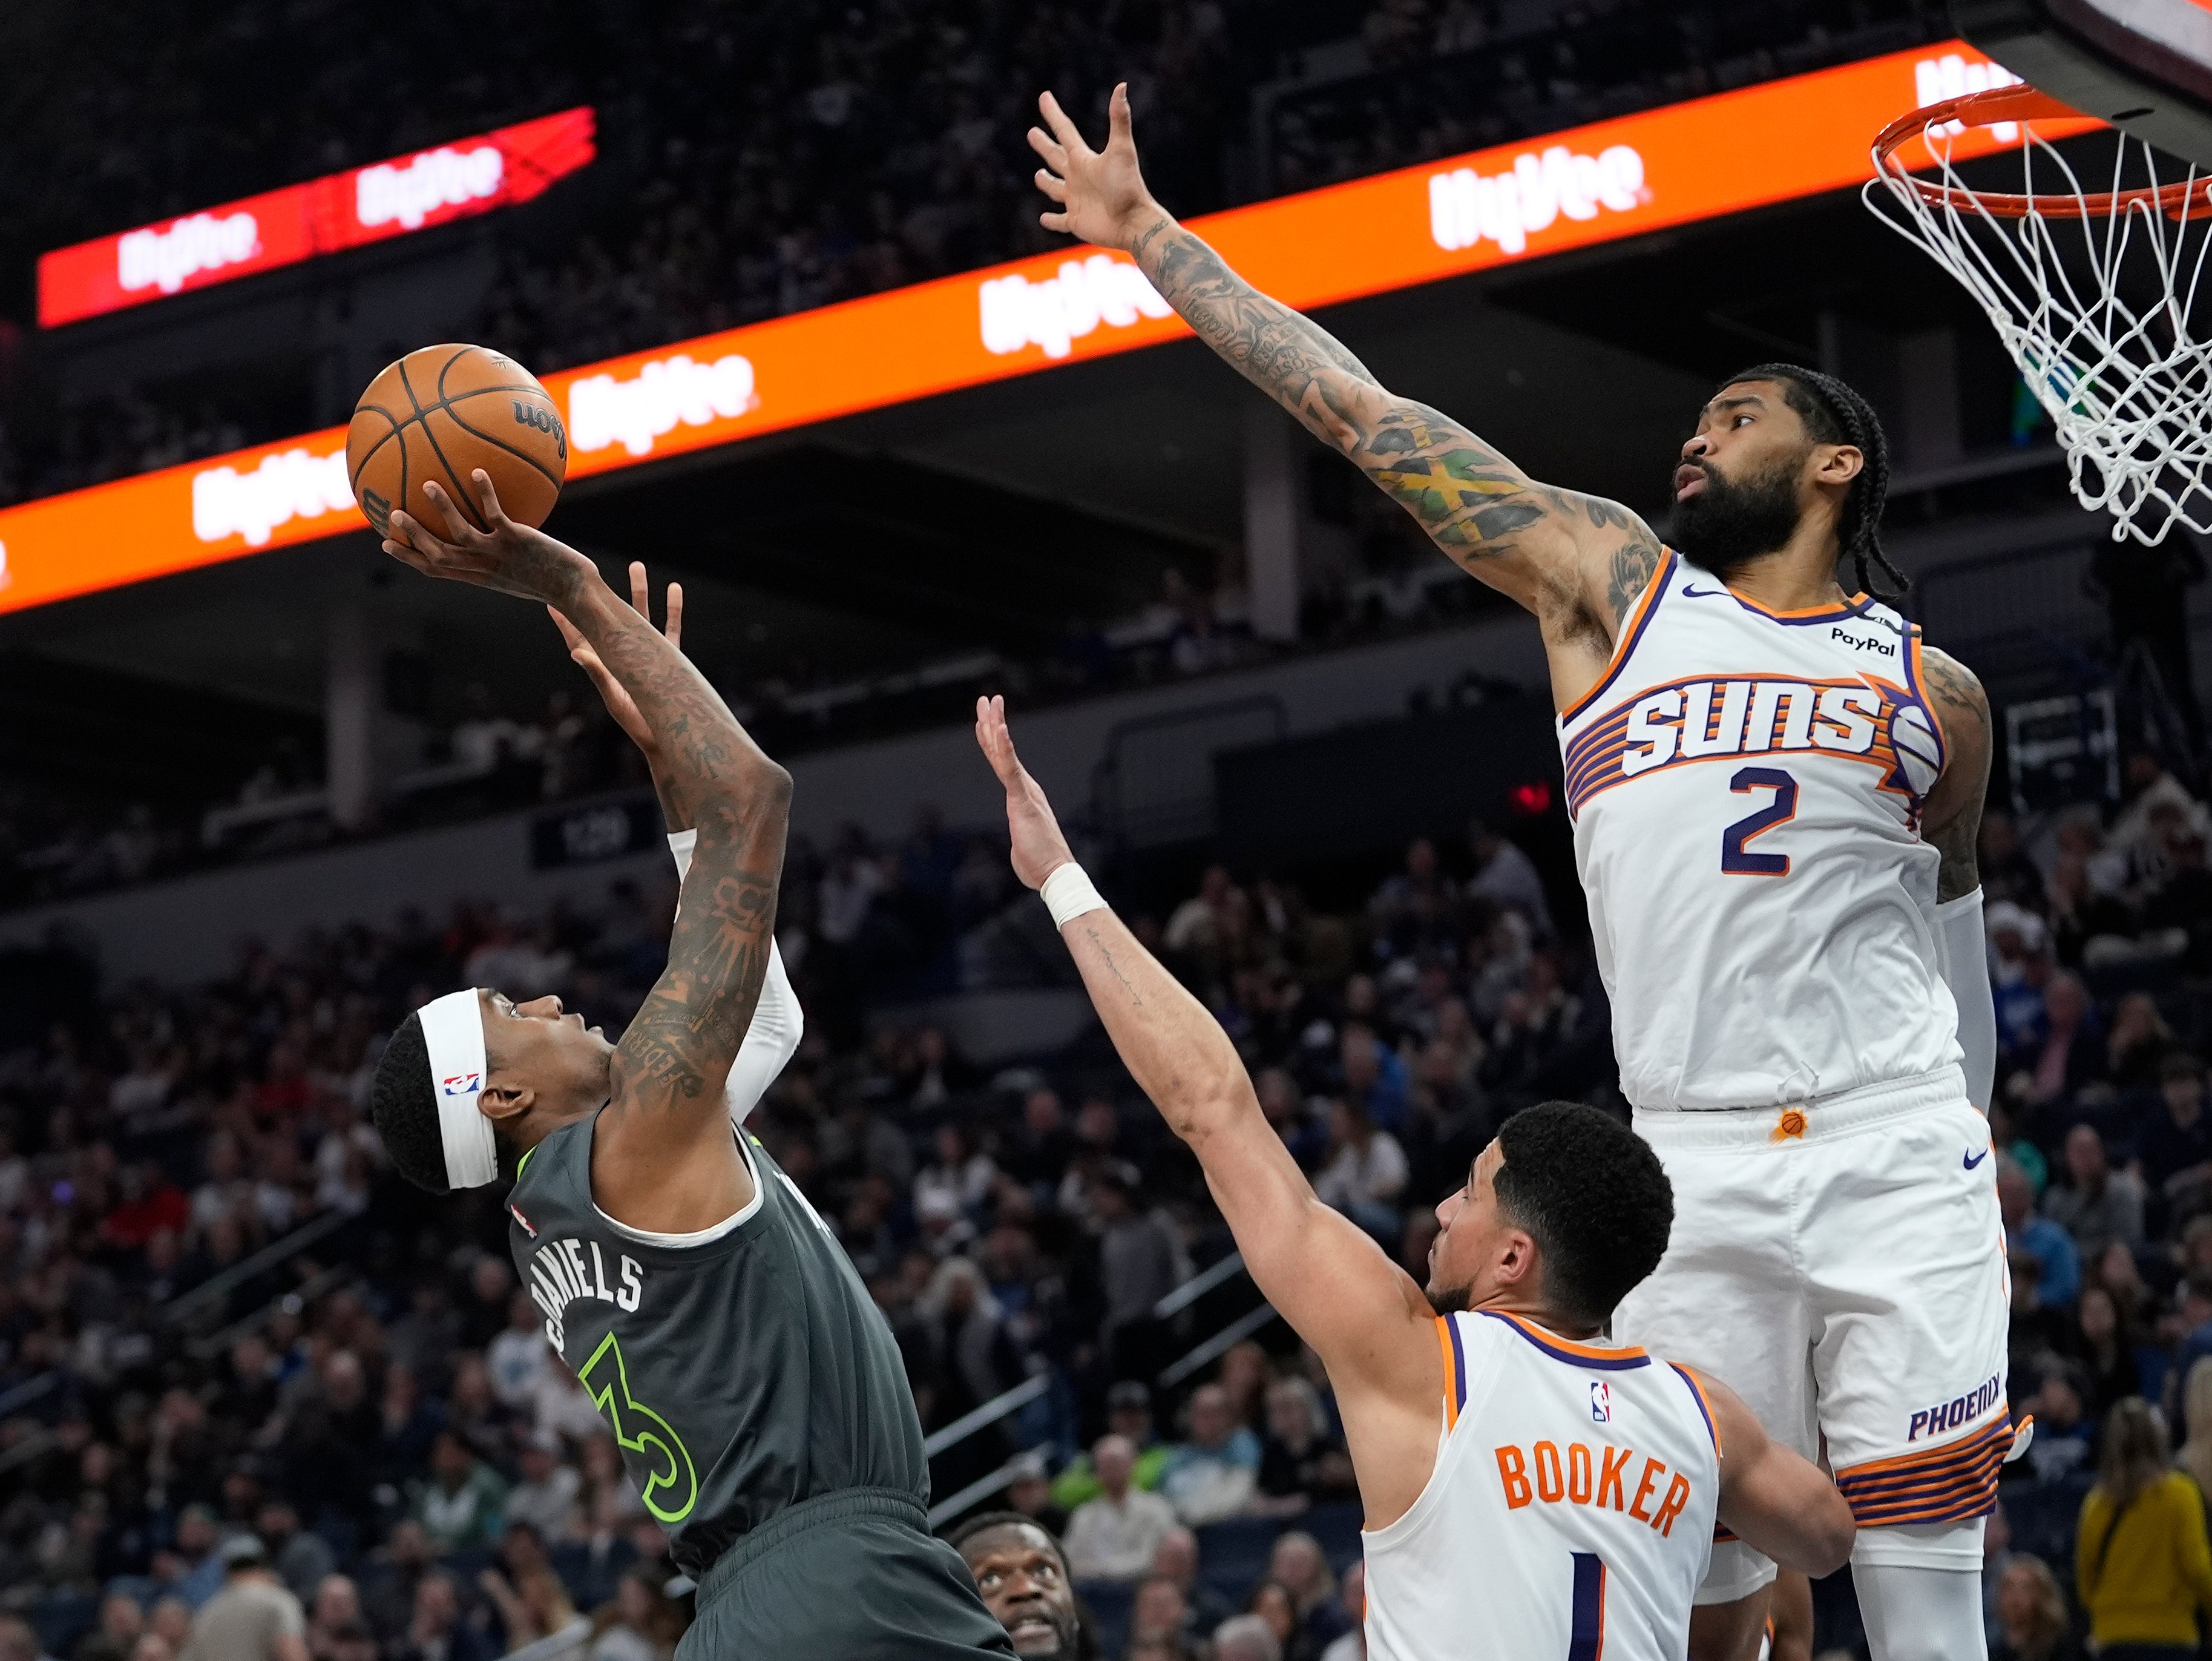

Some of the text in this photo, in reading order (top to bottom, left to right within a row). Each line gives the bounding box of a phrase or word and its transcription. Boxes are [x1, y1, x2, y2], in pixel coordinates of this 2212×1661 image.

[1831, 627, 1895, 657] PayPal
[1621, 681, 1880, 777] SUNS
[1721, 766, 1799, 876] 2
[577, 1330, 698, 1522] 3
[1908, 1371, 2000, 1442] PHOENIX
[1494, 1439, 1690, 1538] BOOKER
[1569, 1550, 1606, 1661] 1
